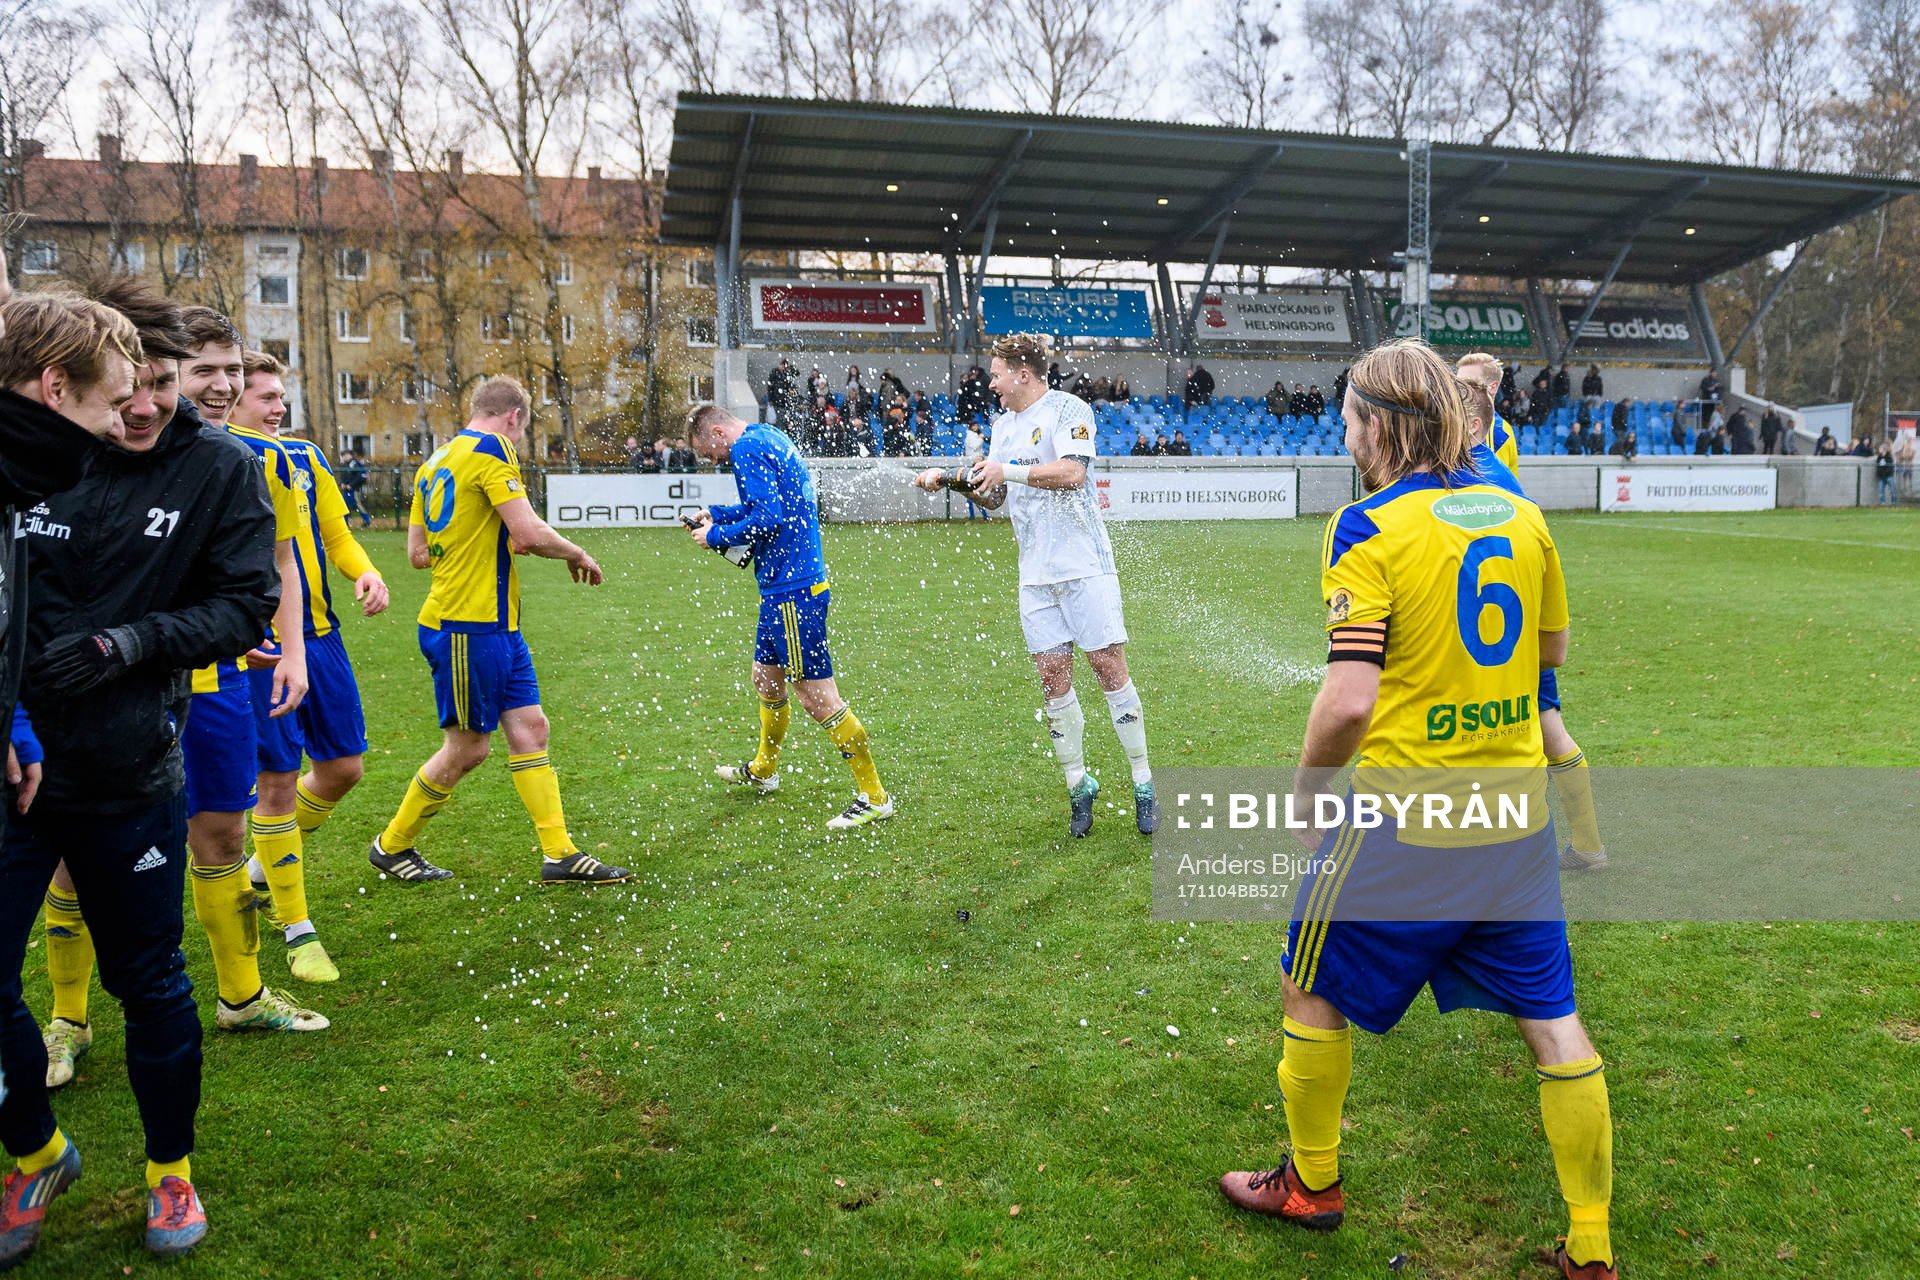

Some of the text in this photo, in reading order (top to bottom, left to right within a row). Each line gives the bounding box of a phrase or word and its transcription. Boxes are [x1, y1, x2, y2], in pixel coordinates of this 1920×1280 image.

[1012, 290, 1118, 306] RESURS
[1014, 305, 1073, 318] BANK
[1237, 303, 1335, 316] HARLYCKANS IP
[1245, 320, 1335, 332] HELSINGBORG
[1424, 305, 1524, 332] SOLID
[1608, 318, 1690, 340] adidas
[668, 479, 702, 499] db
[1131, 490, 1287, 504] FRITID HELSINGBORG
[1647, 484, 1769, 497] FRITID HELSINGBORG
[1443, 502, 1507, 515] Mäklarbyrån
[143, 507, 181, 538] 21
[1457, 535, 1524, 667] 6
[133, 856, 168, 872] adidas
